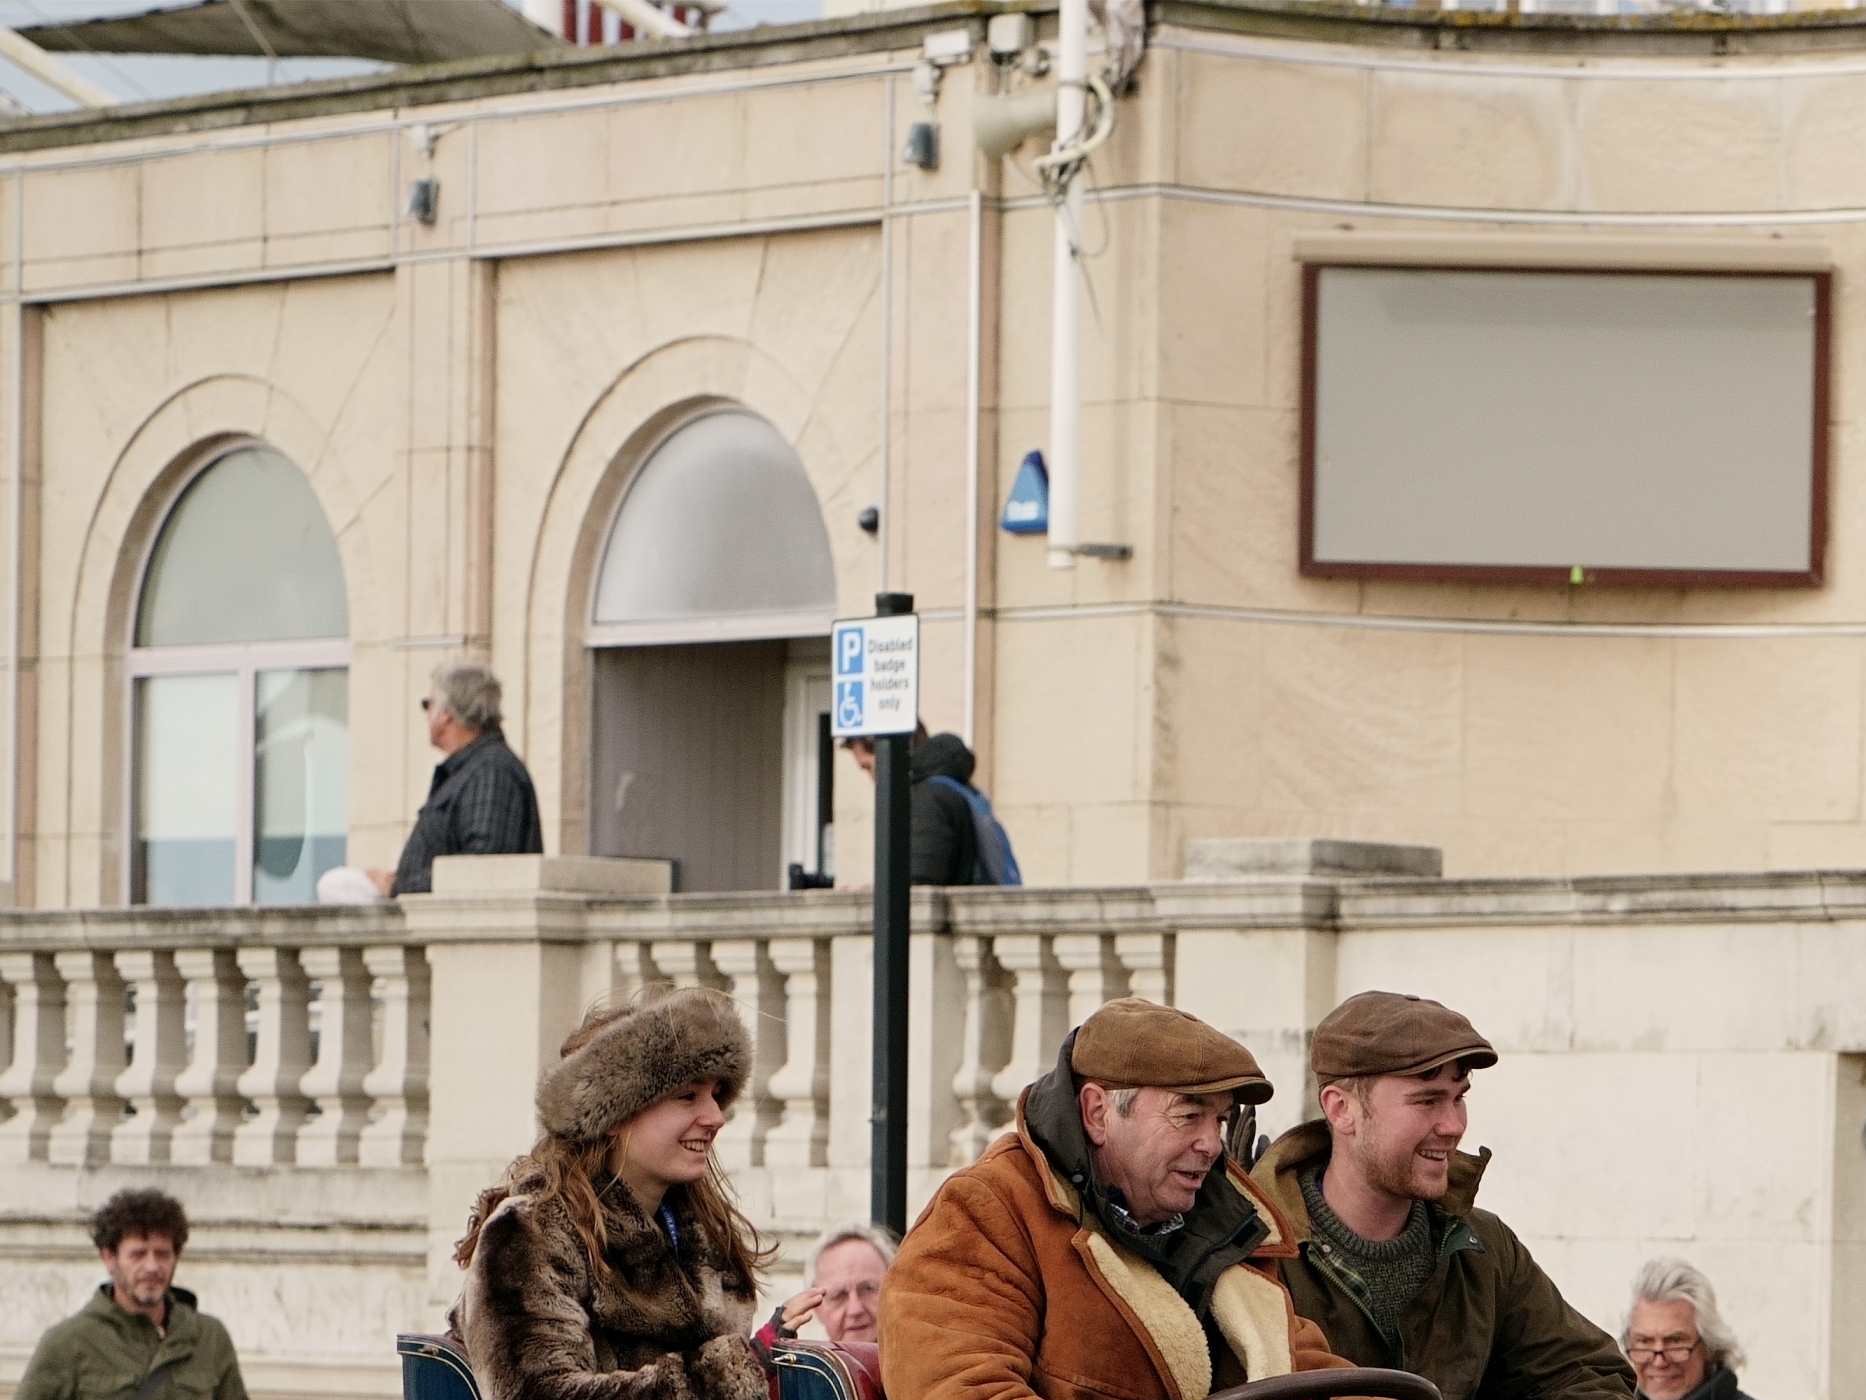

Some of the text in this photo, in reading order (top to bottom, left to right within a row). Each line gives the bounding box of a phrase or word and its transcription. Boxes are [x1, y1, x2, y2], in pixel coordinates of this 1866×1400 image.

[842, 631, 861, 672] P
[868, 637, 913, 654] Disabled
[874, 657, 905, 674] badge
[870, 676, 909, 691] holders
[878, 695, 901, 711] only
